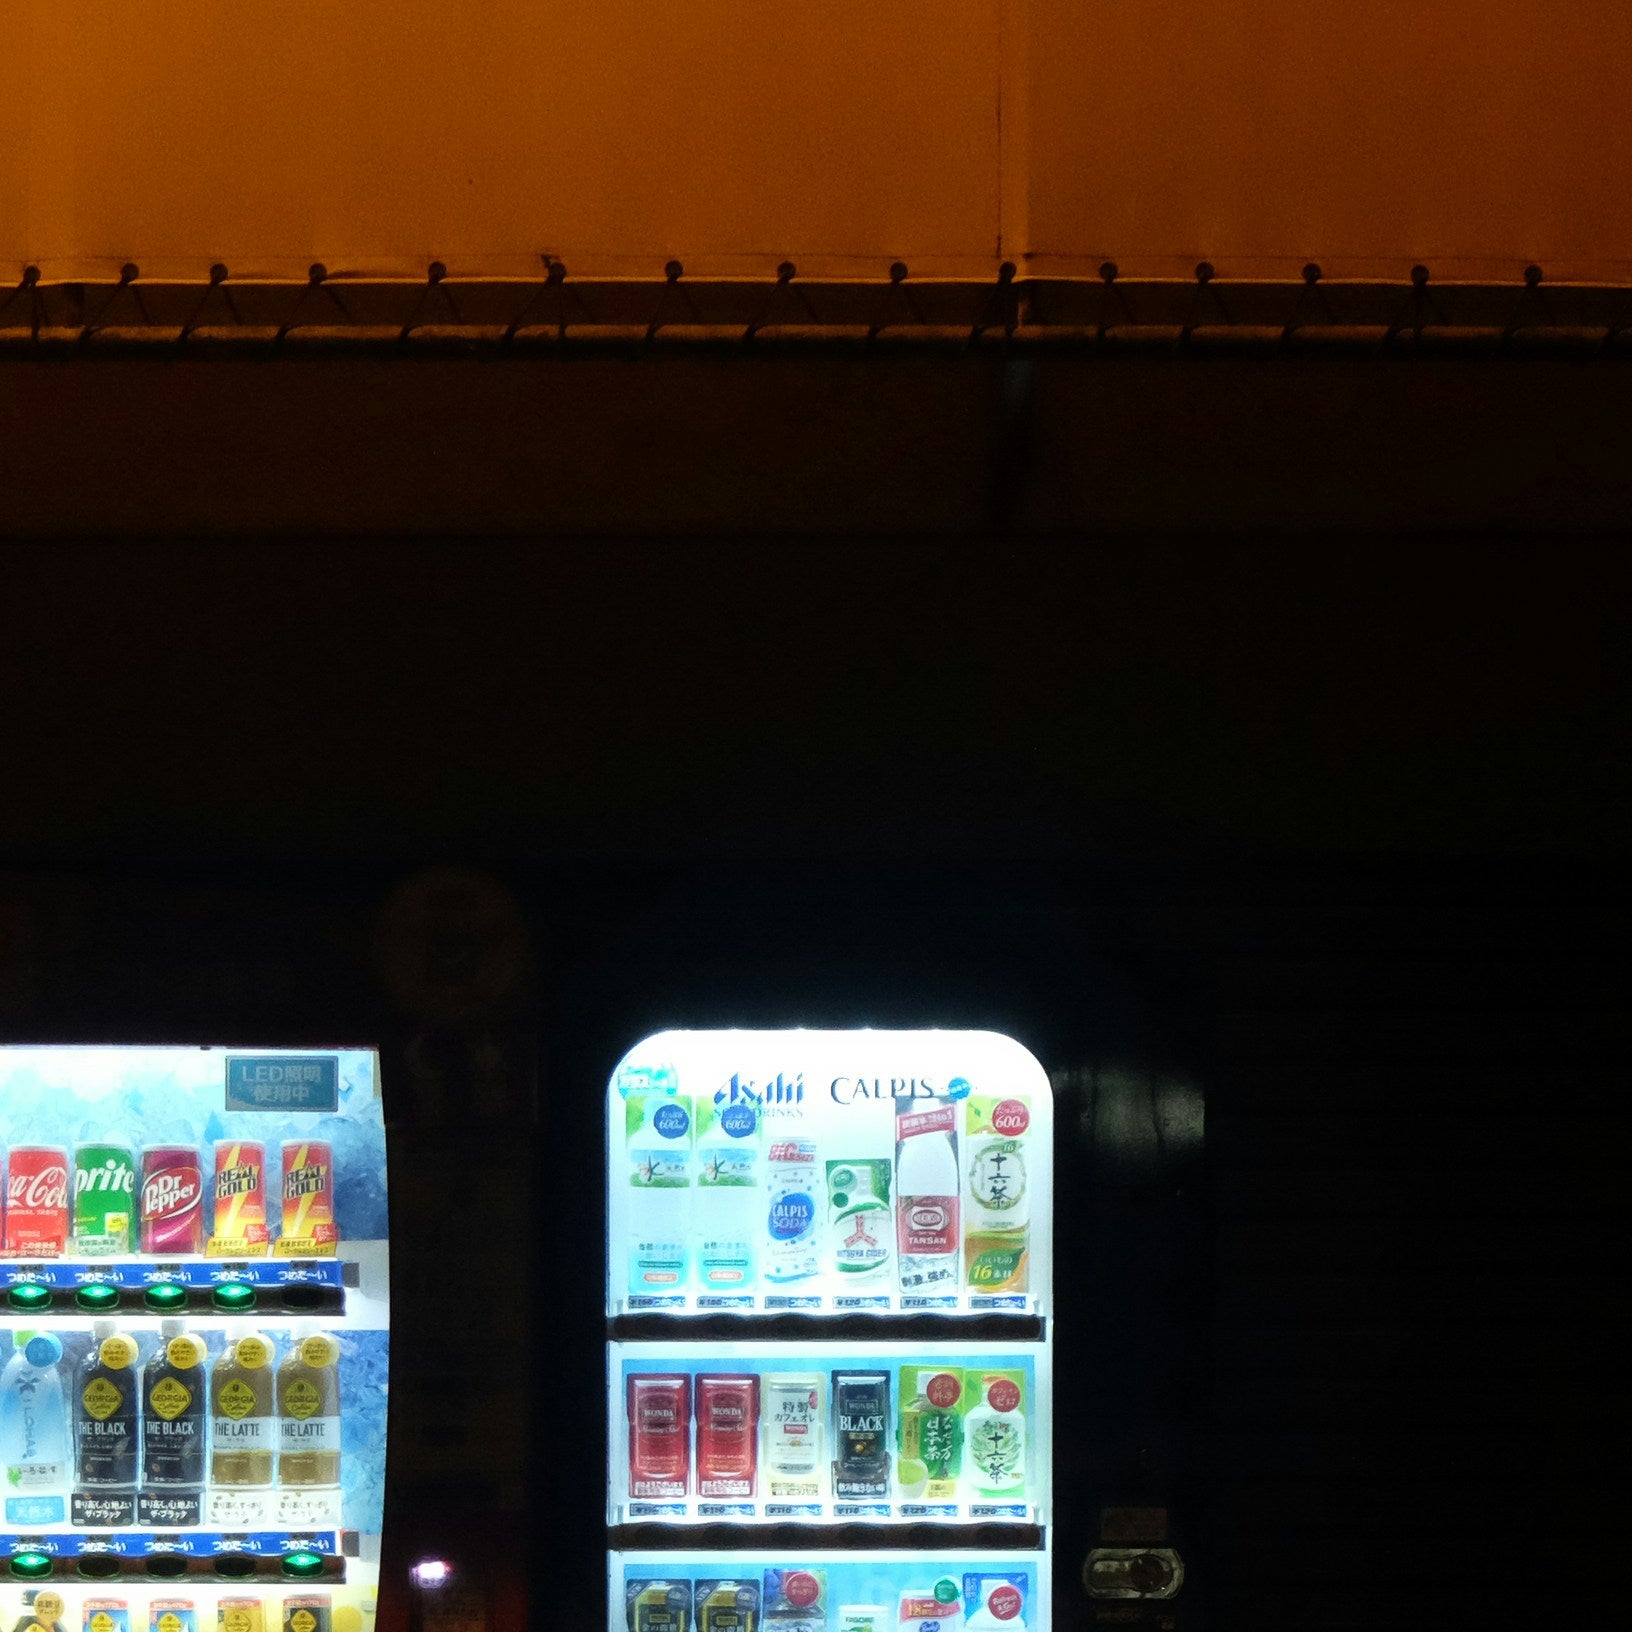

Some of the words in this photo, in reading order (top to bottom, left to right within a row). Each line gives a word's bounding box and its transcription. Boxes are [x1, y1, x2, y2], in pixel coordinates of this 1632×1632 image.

[713, 1072, 805, 1105] Asahi
[830, 1077, 935, 1105] CALPIS
[158, 1175, 182, 1192] Dr
[145, 1183, 195, 1213] Pepper
[772, 1205, 808, 1218] CALPIS
[908, 1237, 947, 1245] TANSAN
[774, 1413, 815, 1423] カフェオレ
[840, 1415, 884, 1431] BLACK
[95, 1421, 126, 1435] BLACK
[162, 1421, 194, 1435] BLACK
[231, 1423, 260, 1436] LATTE
[297, 1423, 325, 1437] LATTE
